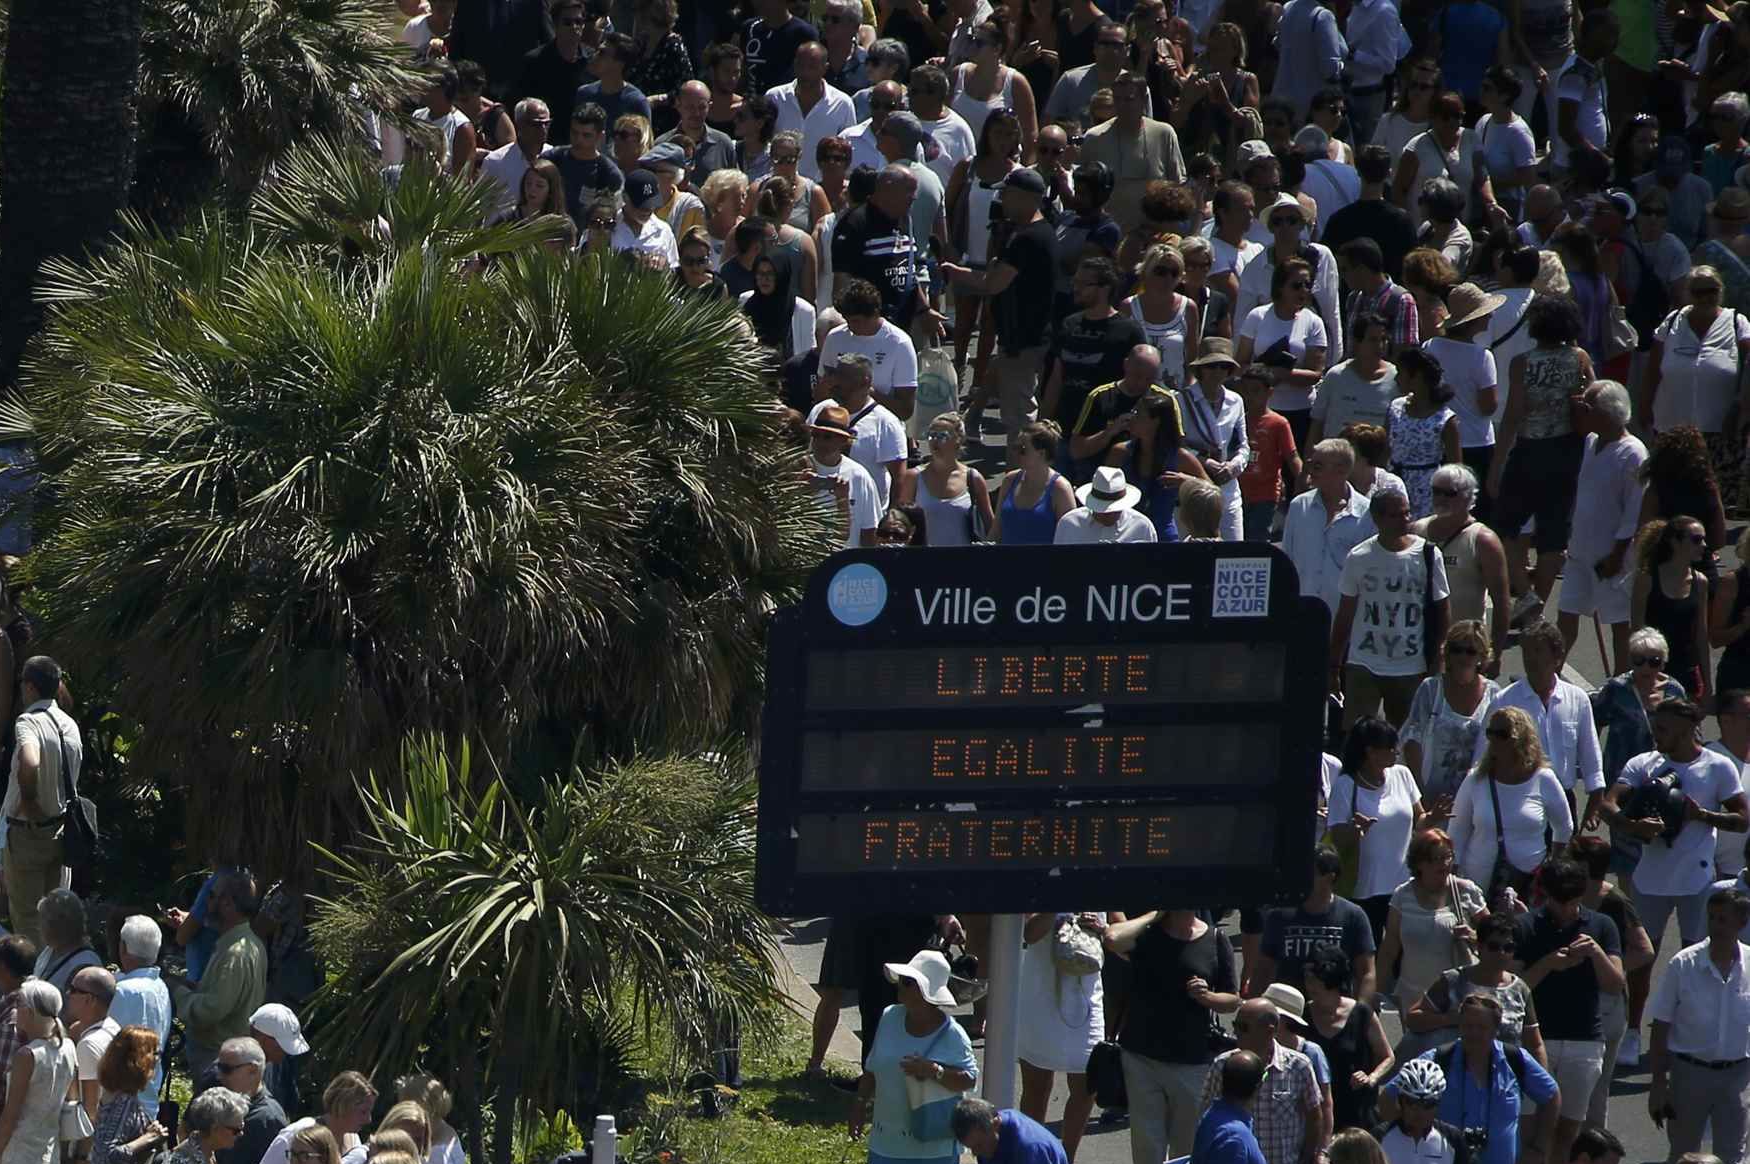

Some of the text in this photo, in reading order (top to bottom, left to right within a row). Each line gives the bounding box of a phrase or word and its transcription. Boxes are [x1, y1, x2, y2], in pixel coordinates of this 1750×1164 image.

[1217, 570, 1267, 585] NICE
[914, 586, 997, 625] Ville
[1015, 586, 1067, 623] de
[1086, 583, 1193, 621] NICE
[1216, 599, 1265, 613] AZUR
[1357, 630, 1419, 658] AYS
[937, 654, 1150, 695] LIBERTE
[932, 736, 1146, 777] EGALITE
[864, 817, 1172, 859] FRATERNITE
